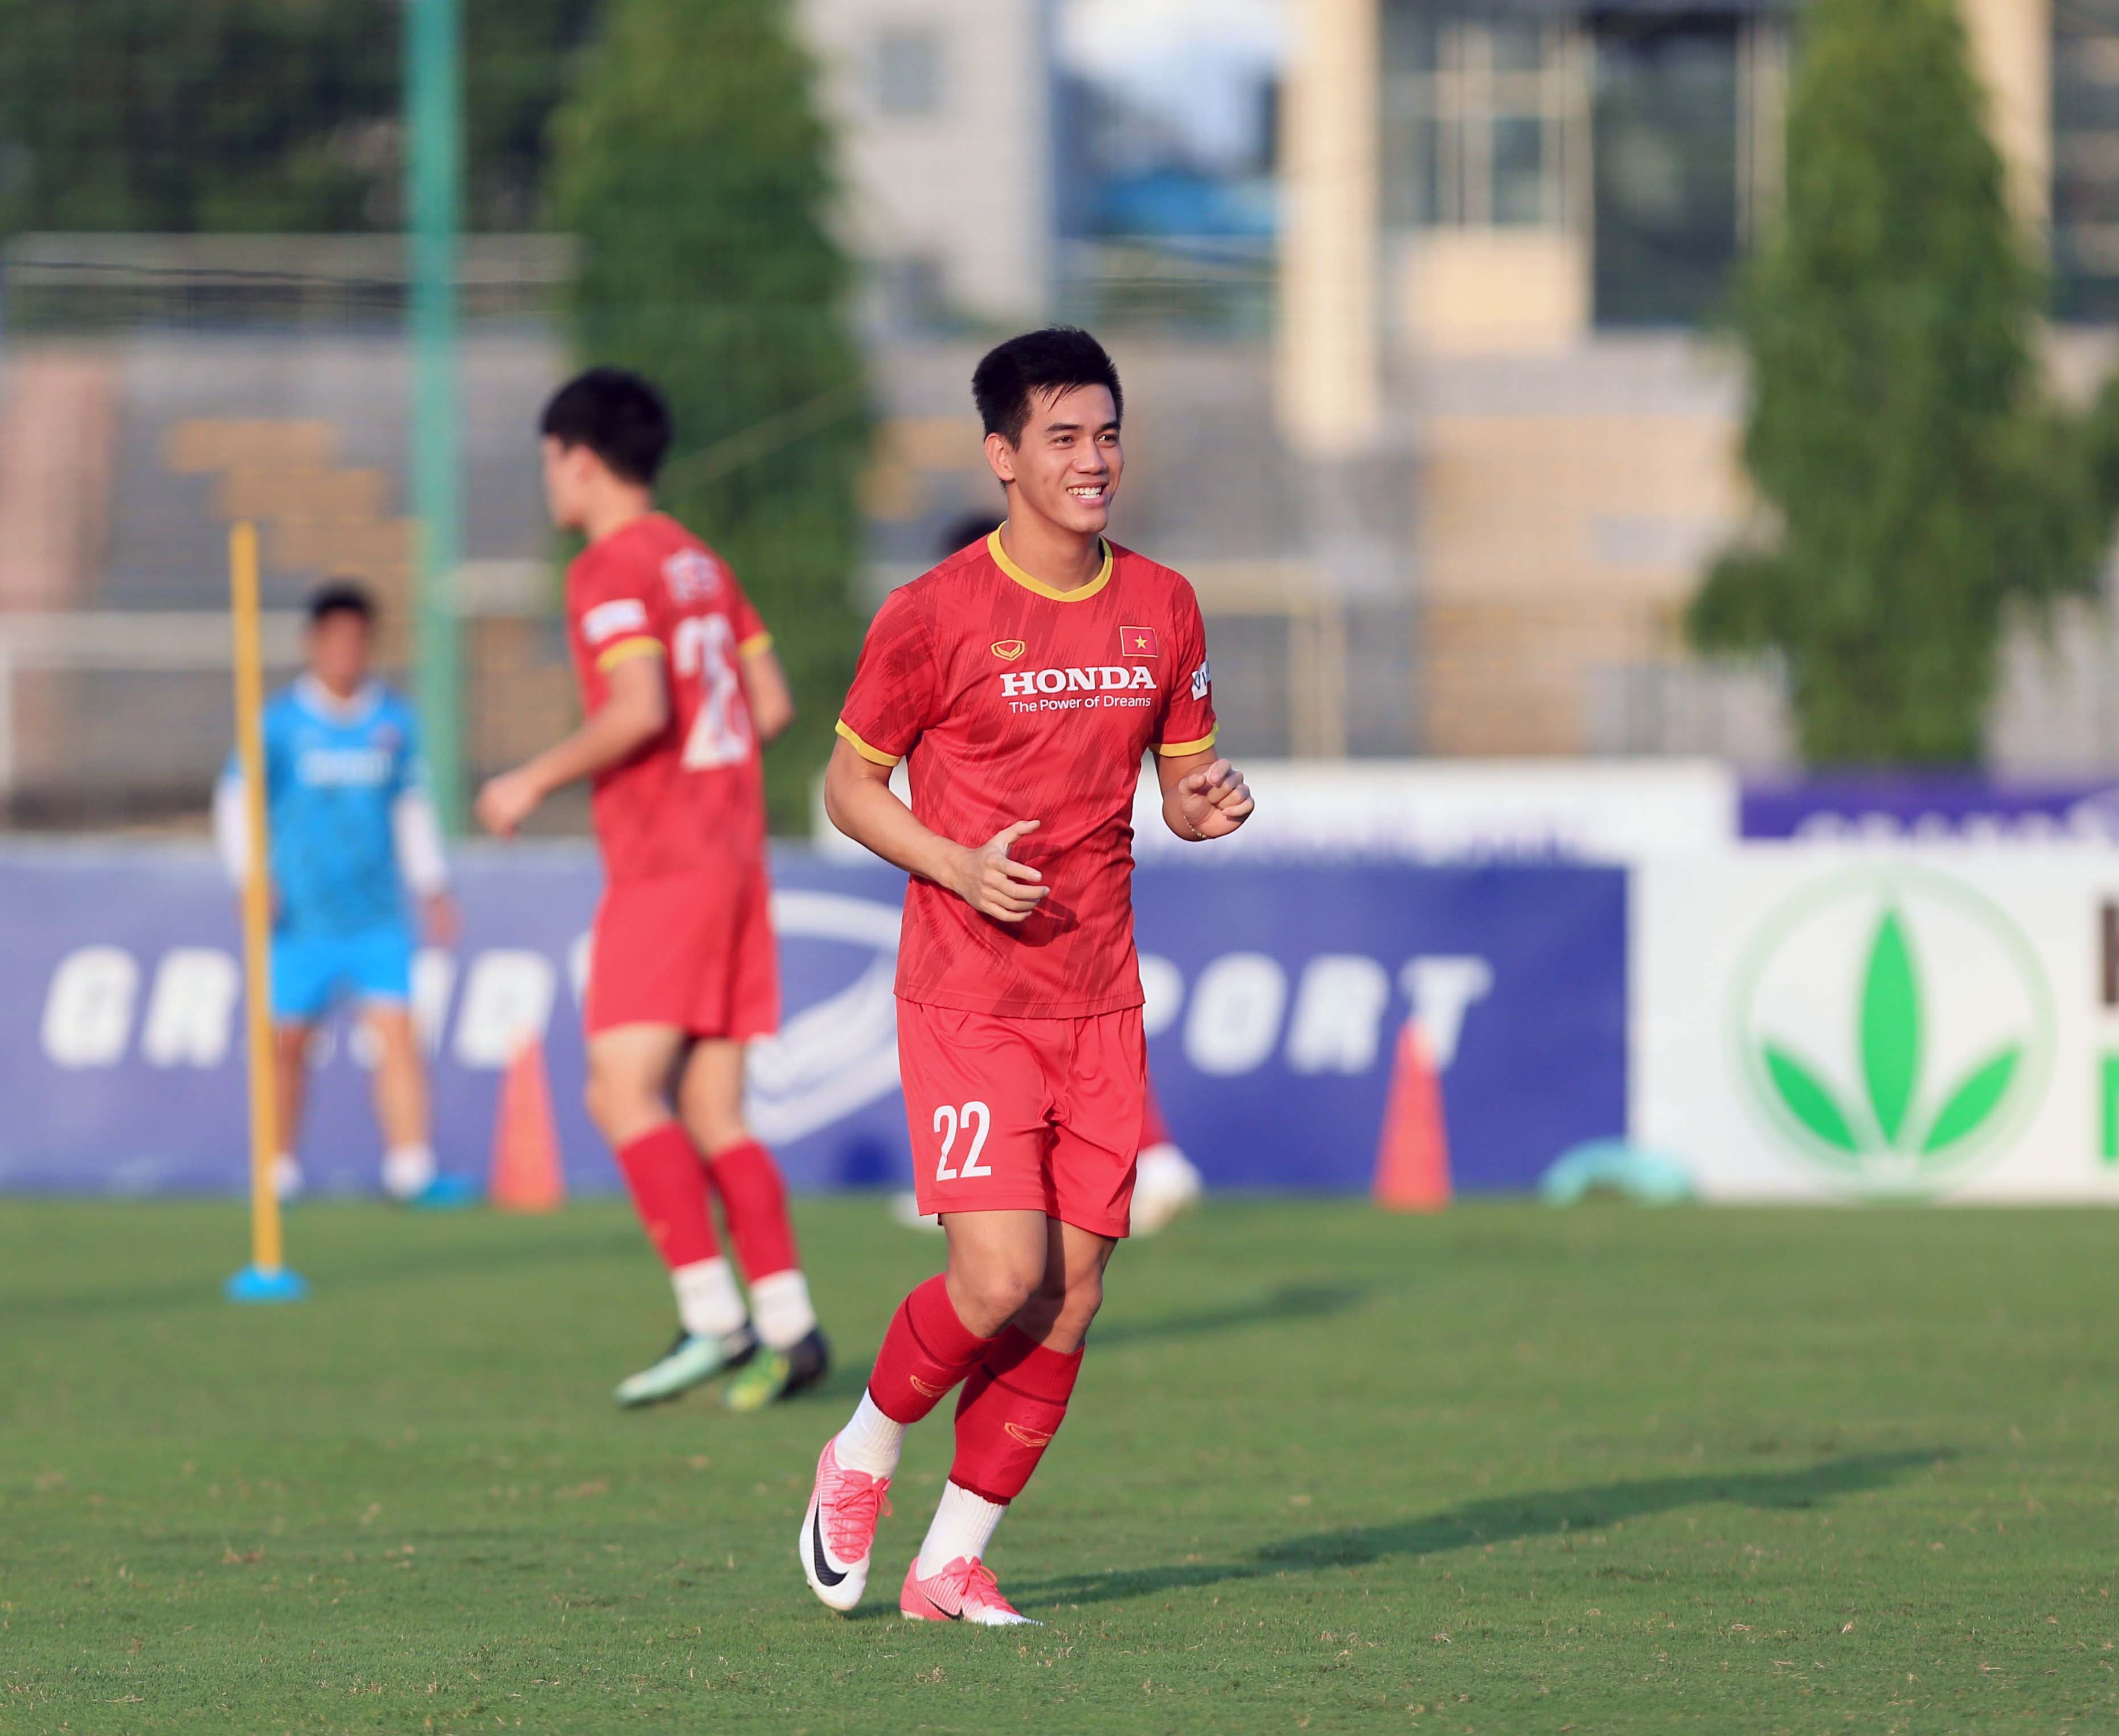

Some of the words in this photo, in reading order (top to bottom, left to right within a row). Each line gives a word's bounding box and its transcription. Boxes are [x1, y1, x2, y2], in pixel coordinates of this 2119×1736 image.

[999, 666, 1157, 697] HONDA
[1008, 701, 1037, 714] The
[1039, 698, 1083, 711] Power
[1084, 695, 1100, 707] of
[1102, 695, 1151, 707] Dreams
[41, 944, 555, 1071] GRD
[1138, 952, 1495, 1076] PORT
[933, 1100, 992, 1182] 22
